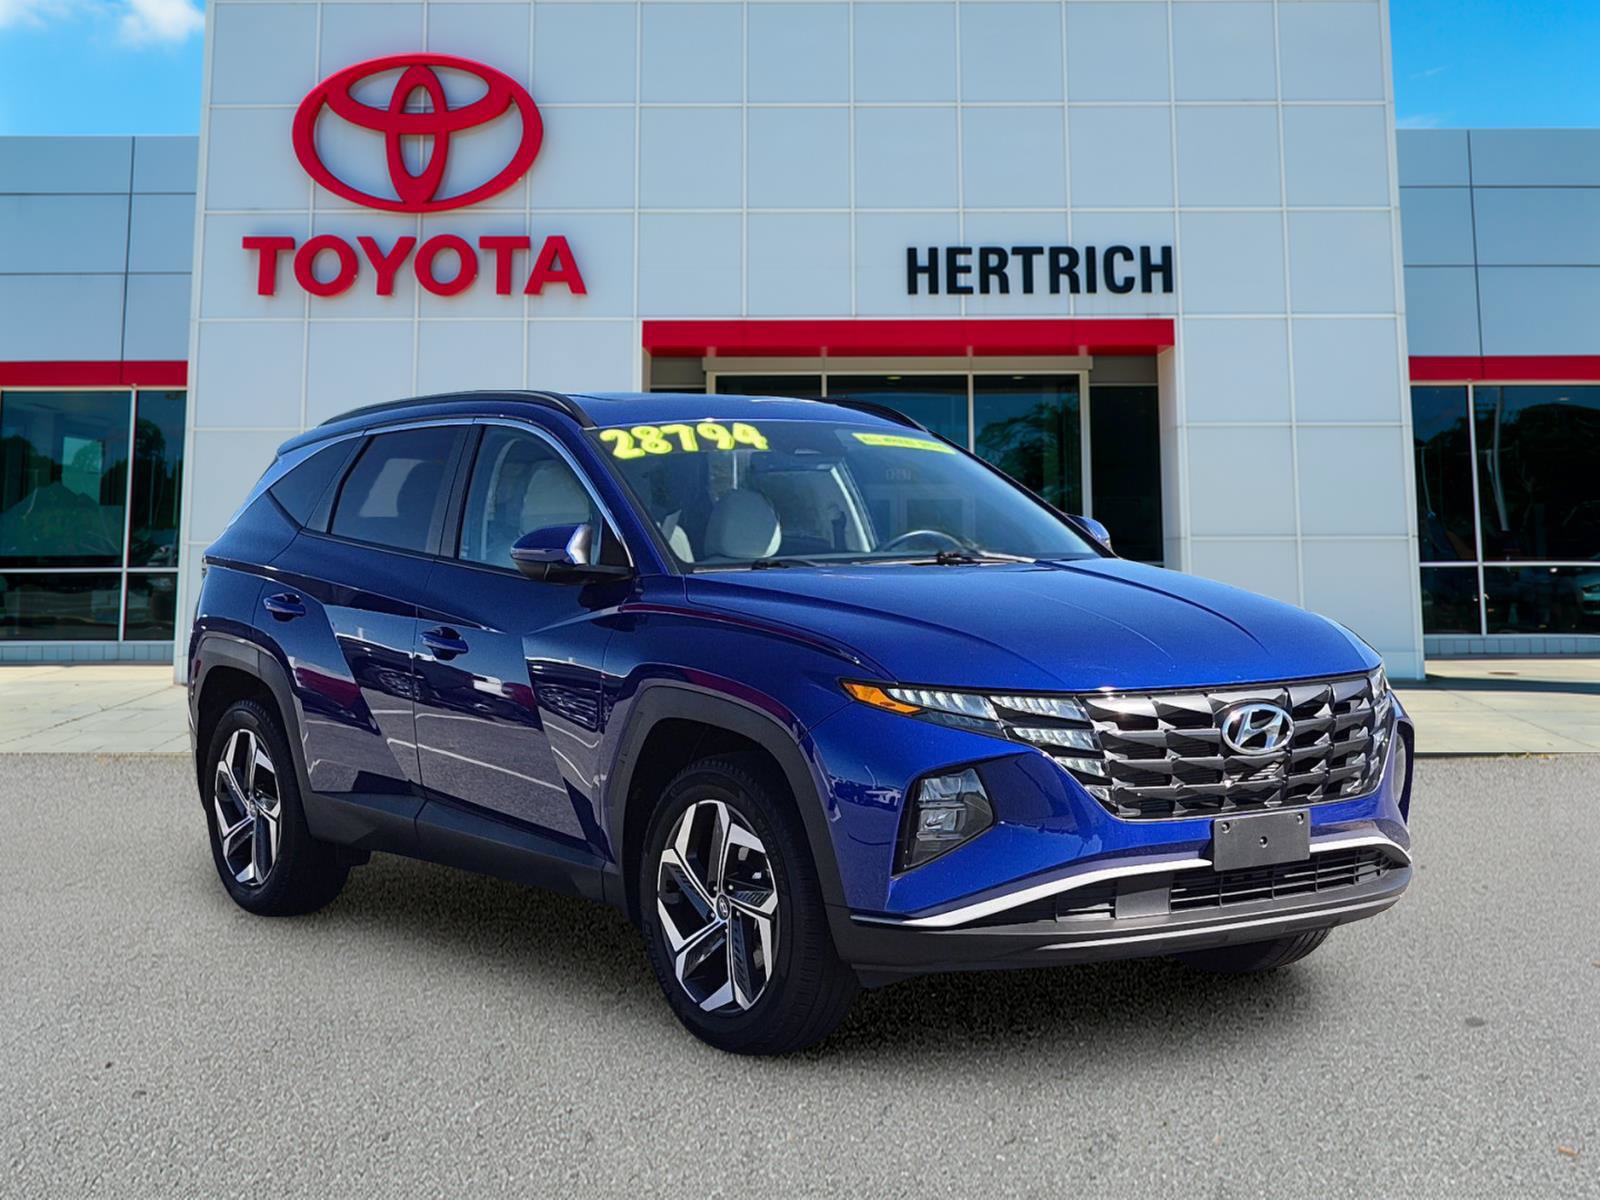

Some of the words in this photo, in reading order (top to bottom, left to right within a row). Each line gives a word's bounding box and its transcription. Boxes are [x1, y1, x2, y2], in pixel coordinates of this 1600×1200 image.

[242, 234, 587, 297] TOYOTA
[907, 245, 1174, 295] HERTRICH
[599, 421, 769, 459] 28794
